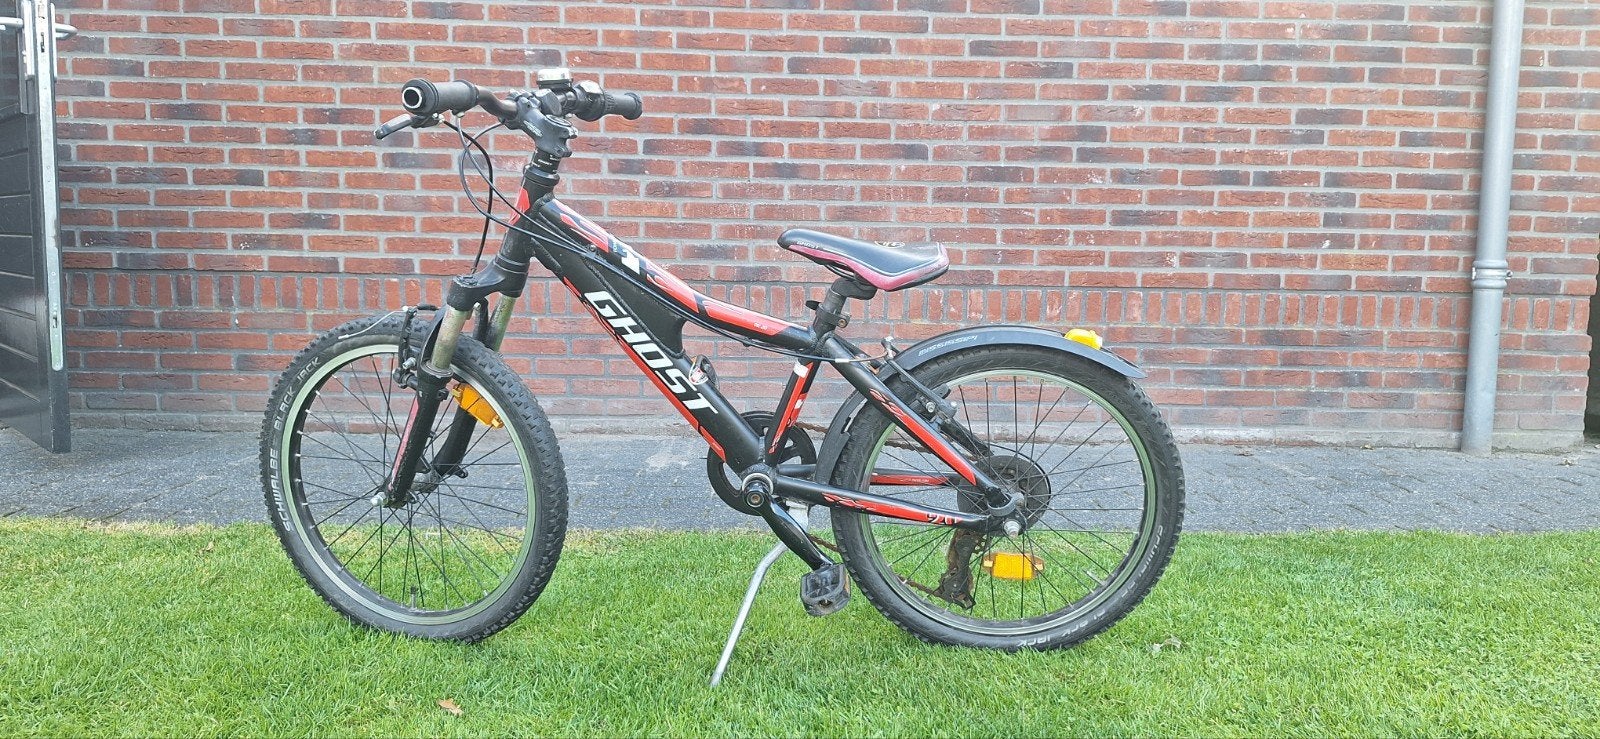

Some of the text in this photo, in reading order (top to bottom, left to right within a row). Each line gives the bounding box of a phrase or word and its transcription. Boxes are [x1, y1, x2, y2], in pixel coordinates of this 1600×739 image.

[584, 290, 719, 414] GHOST
[269, 356, 321, 532] SCHWALBE BLACK JACK
